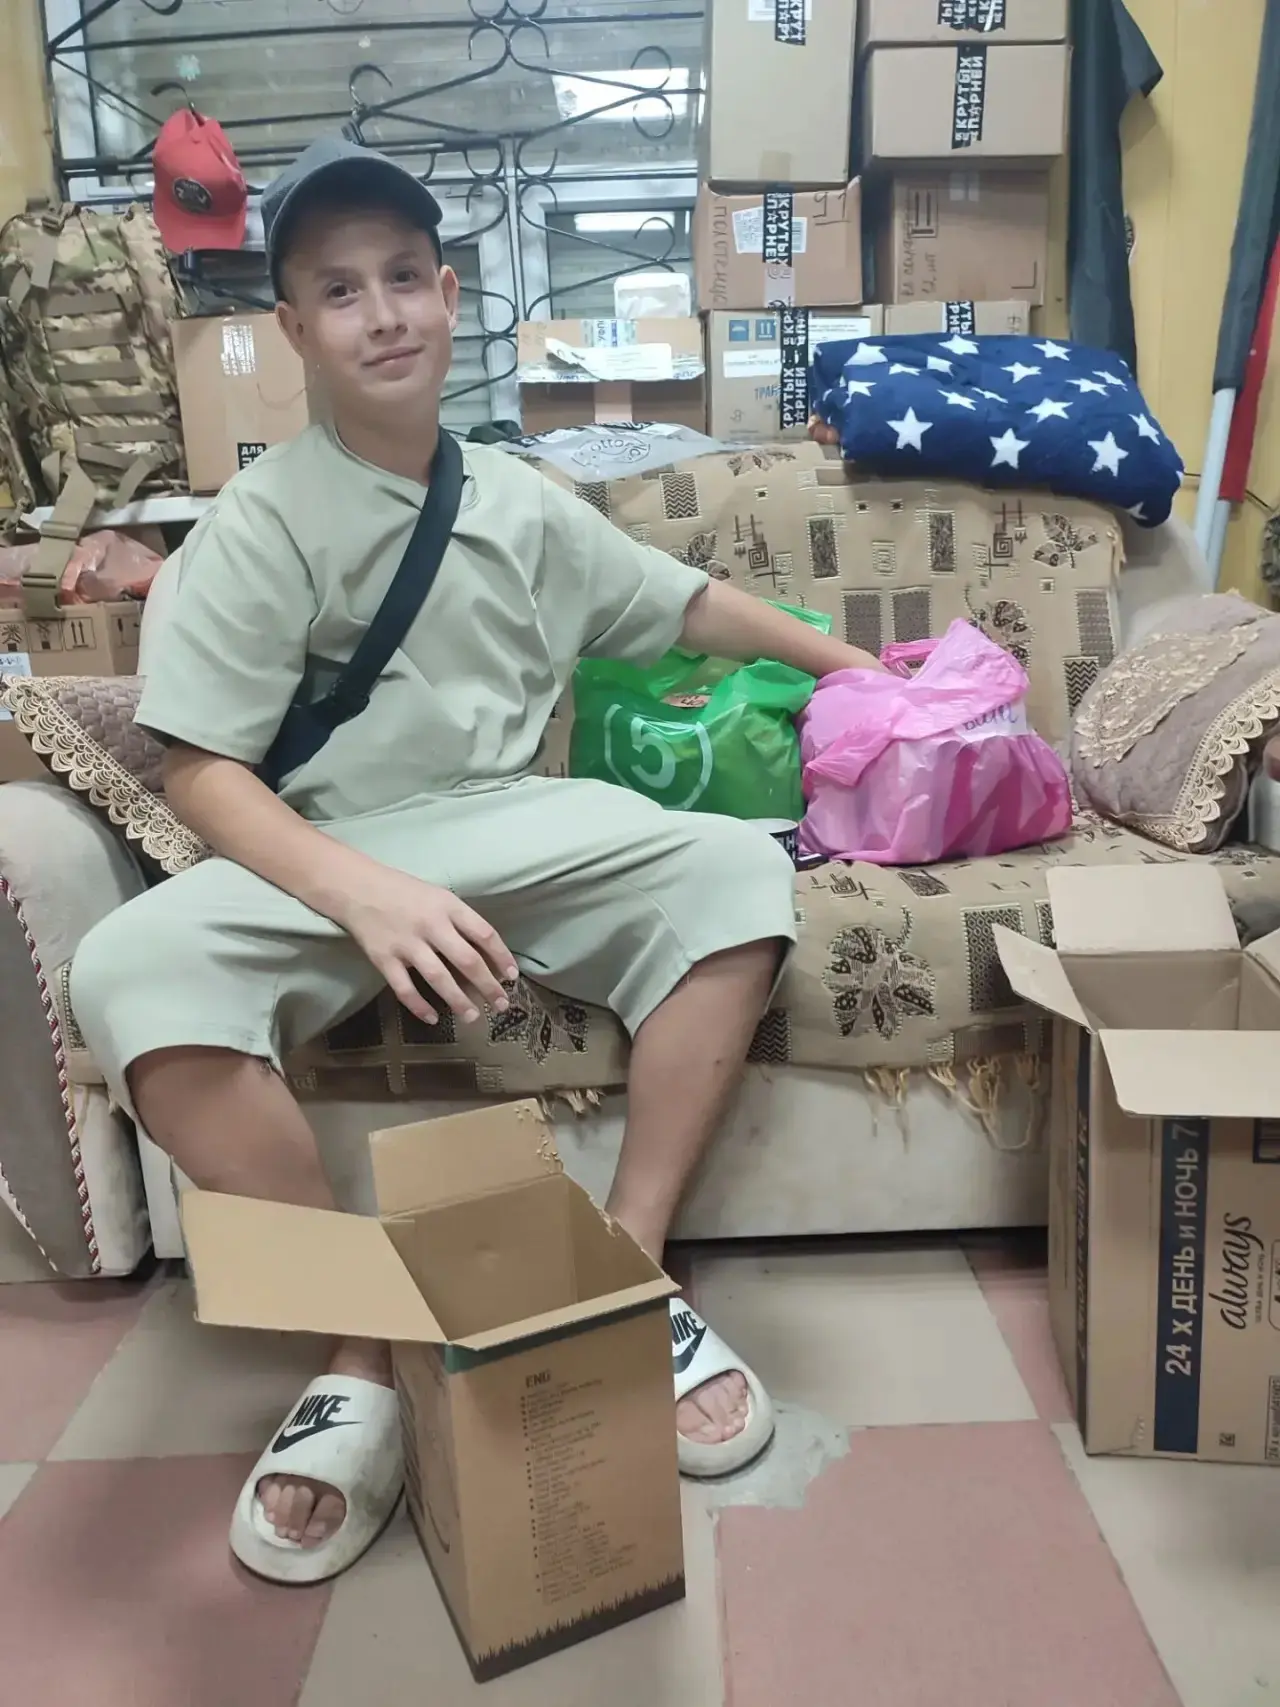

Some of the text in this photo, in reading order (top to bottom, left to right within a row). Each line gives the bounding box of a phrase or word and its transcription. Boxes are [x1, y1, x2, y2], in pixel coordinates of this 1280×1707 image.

[631, 715, 680, 790] 5
[1174, 1148, 1199, 1217] НОЧЬ
[1172, 1246, 1198, 1315] ДЕНЬ
[1208, 1213, 1264, 1330] always
[1165, 1344, 1192, 1376] 24
[286, 1394, 351, 1428] NIKE
